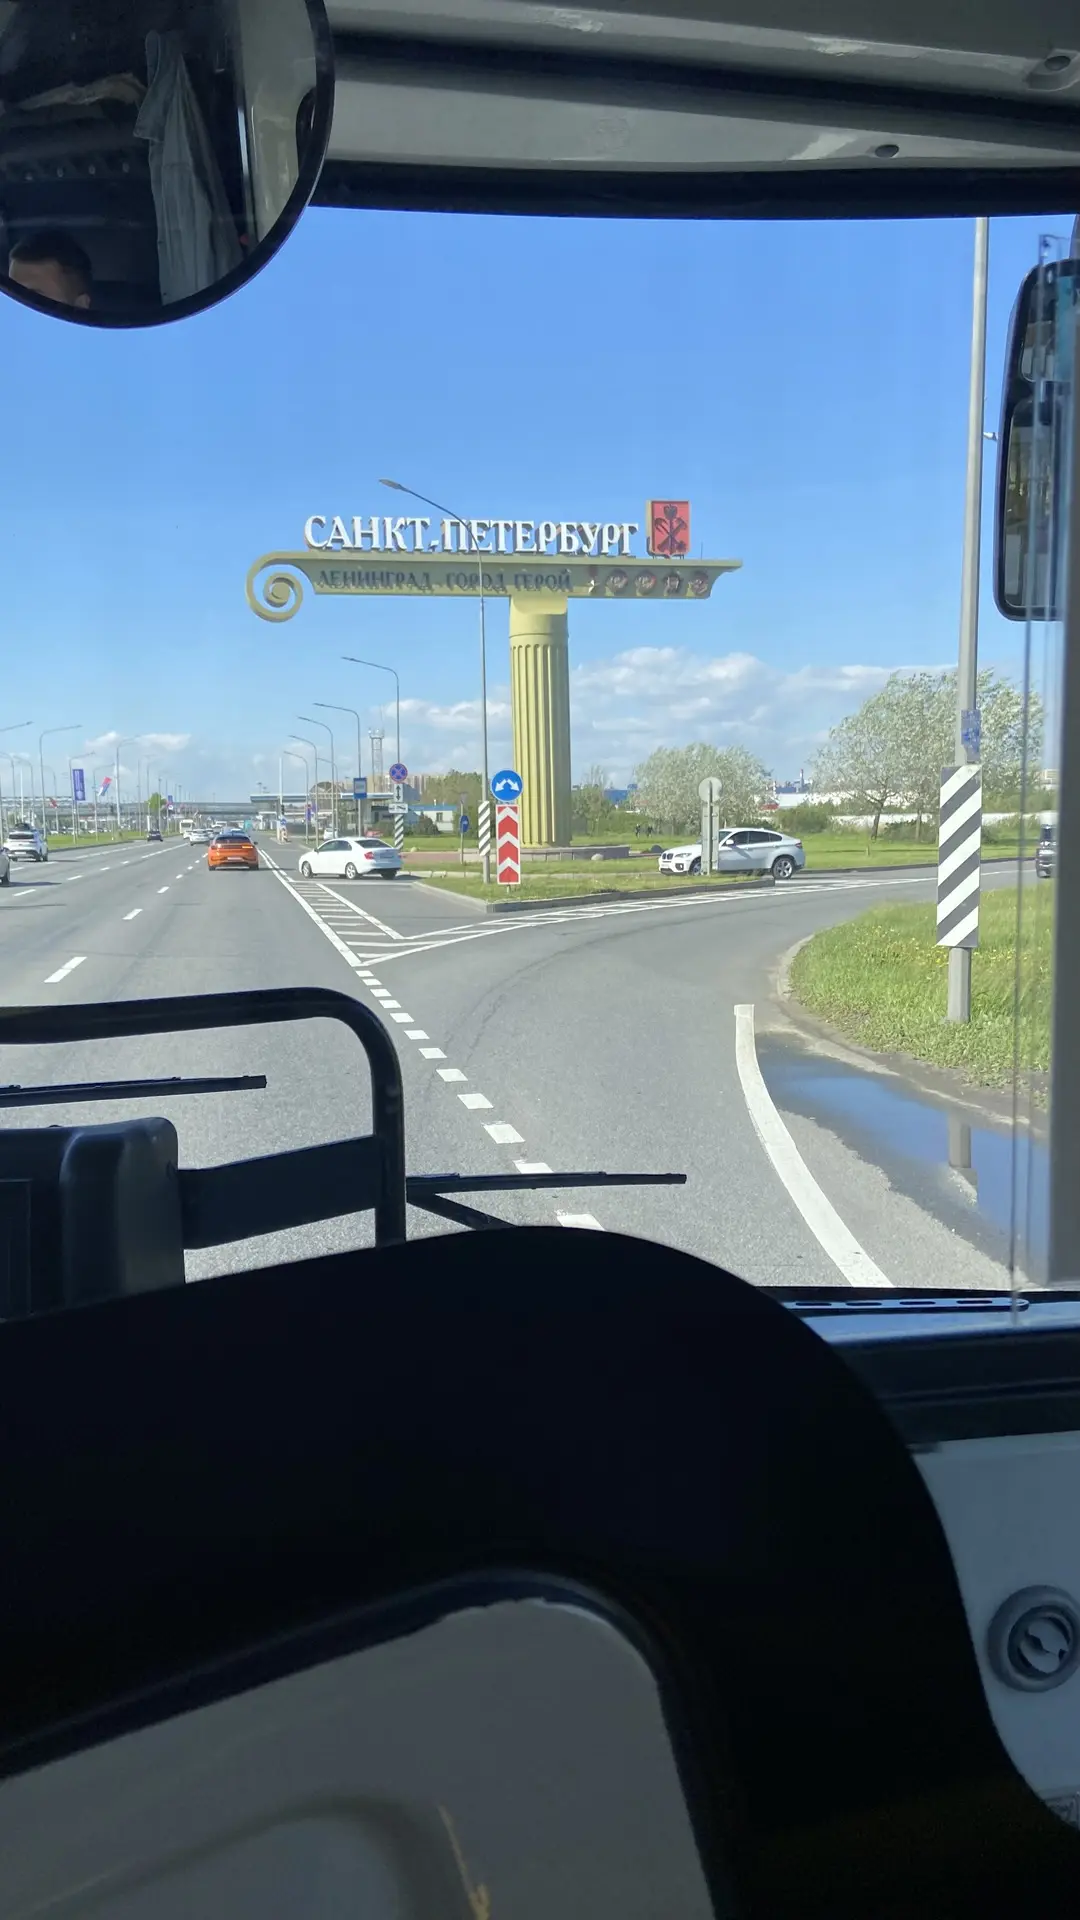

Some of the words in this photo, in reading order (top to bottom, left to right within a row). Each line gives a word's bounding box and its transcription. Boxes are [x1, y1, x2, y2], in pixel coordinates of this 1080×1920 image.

[318, 568, 432, 591] ЛЕНИНГРАД
[446, 571, 508, 592] ГОРОД
[514, 568, 574, 592] ГЕРОЙ
